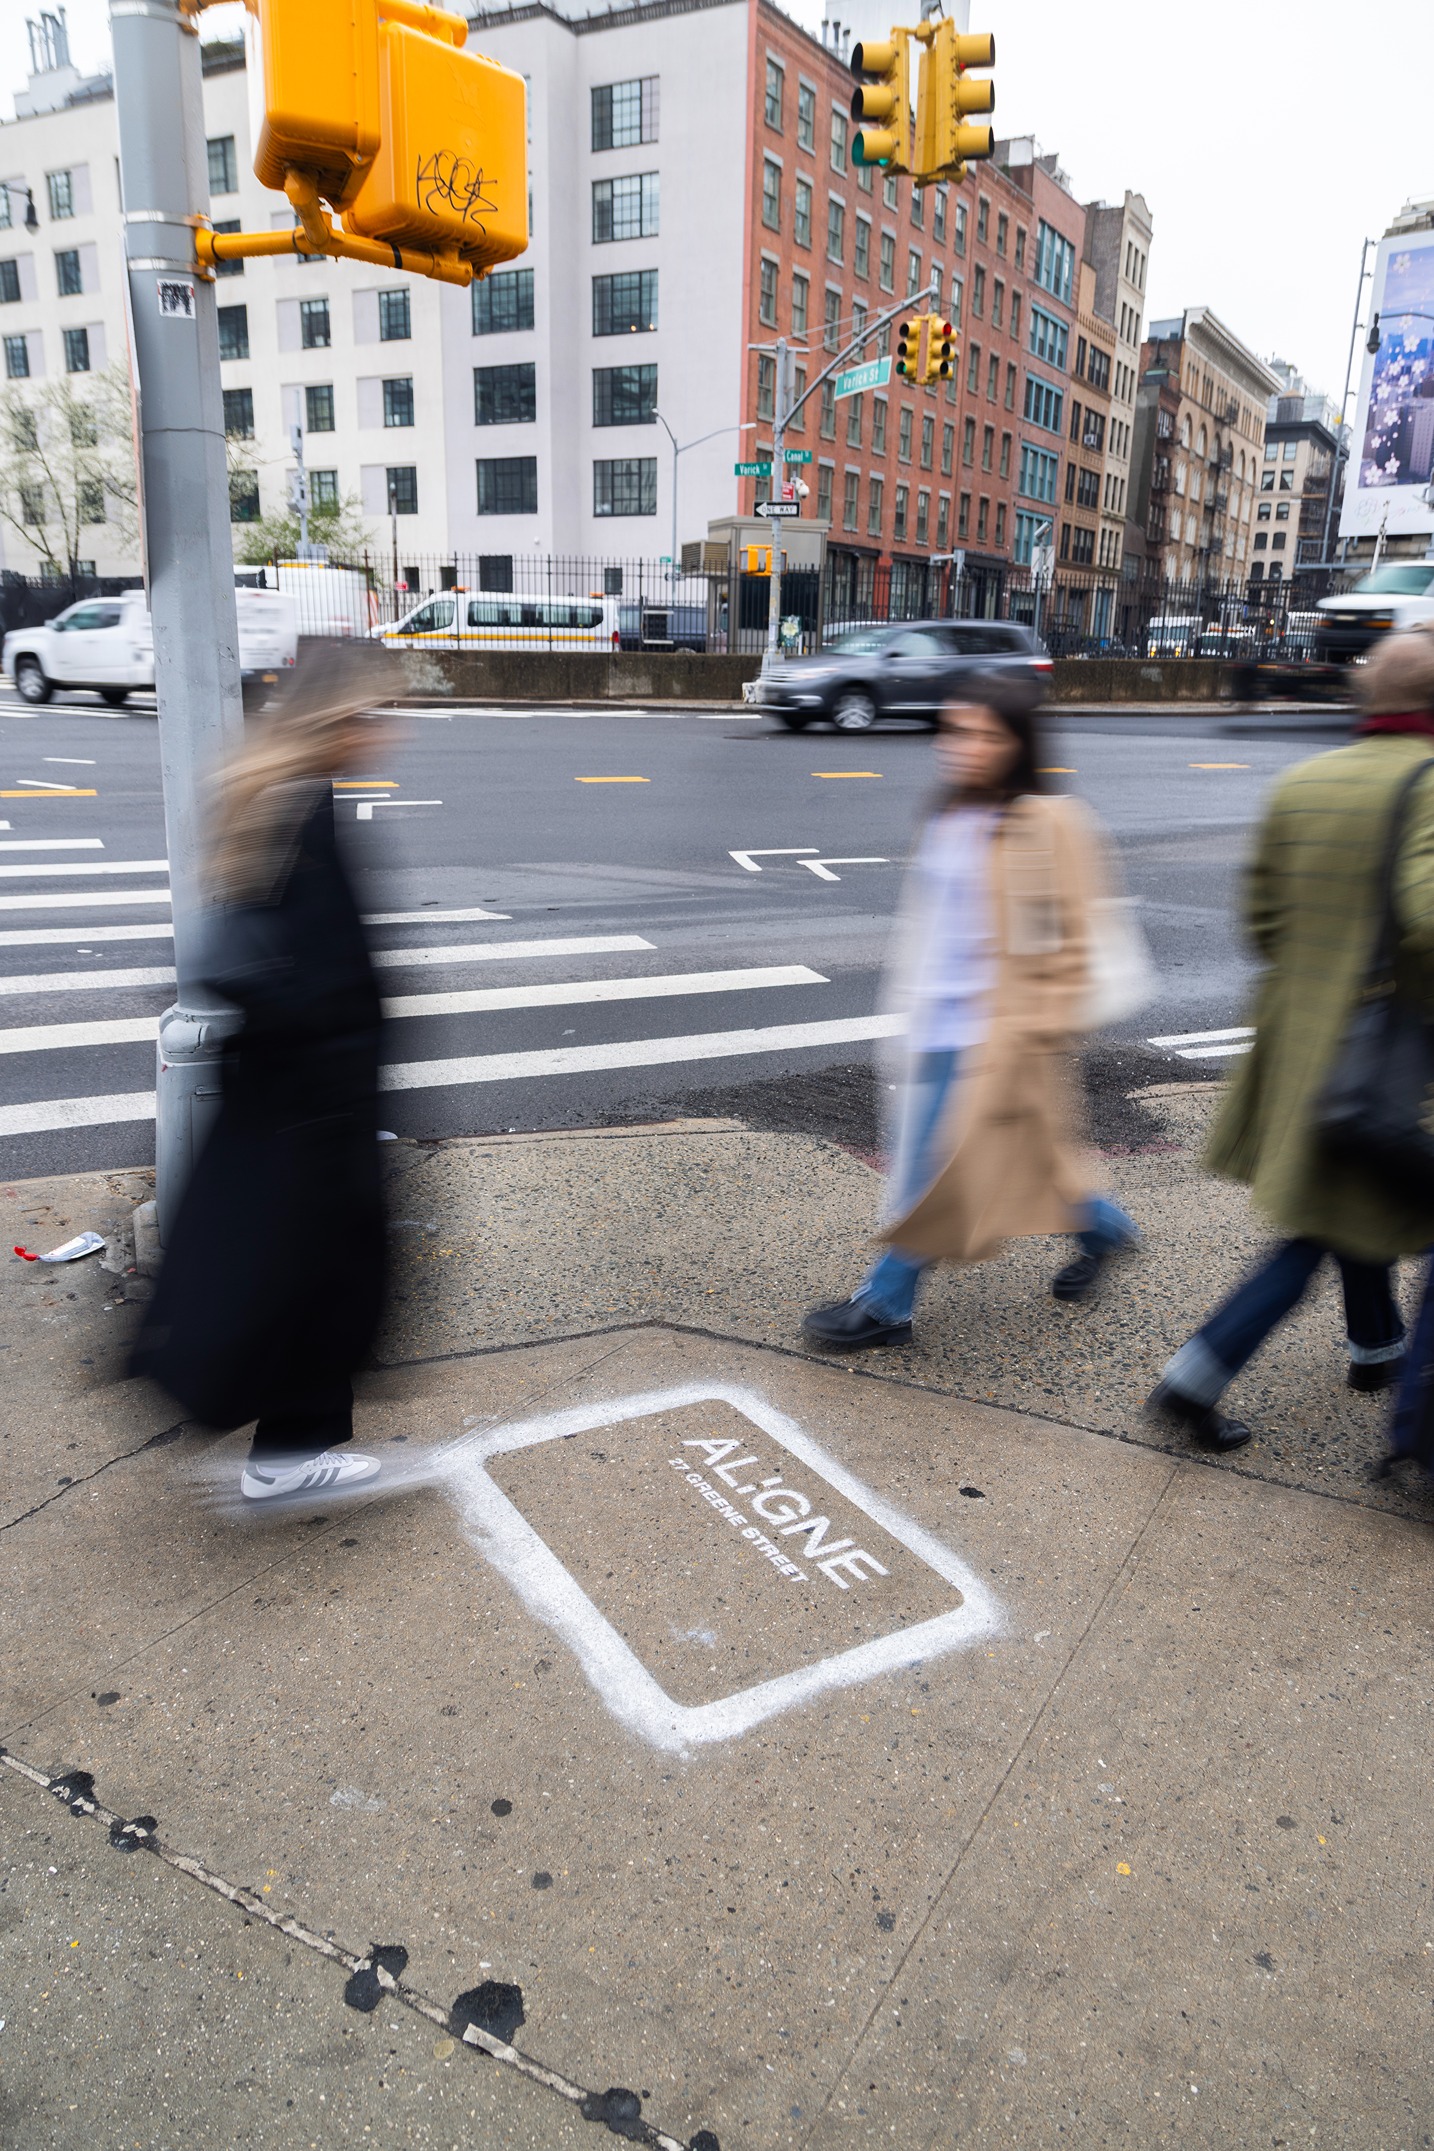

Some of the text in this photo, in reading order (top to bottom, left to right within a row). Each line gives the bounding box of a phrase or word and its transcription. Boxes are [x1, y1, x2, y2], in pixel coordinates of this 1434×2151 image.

[843, 367, 879, 390] Varick St
[786, 451, 803, 462] Canal
[739, 464, 760, 475] Varick
[761, 505, 794, 514] ONE WAY
[668, 1457, 810, 1582] 27 GREENE STREET
[680, 1438, 891, 1590] ALIGNE
